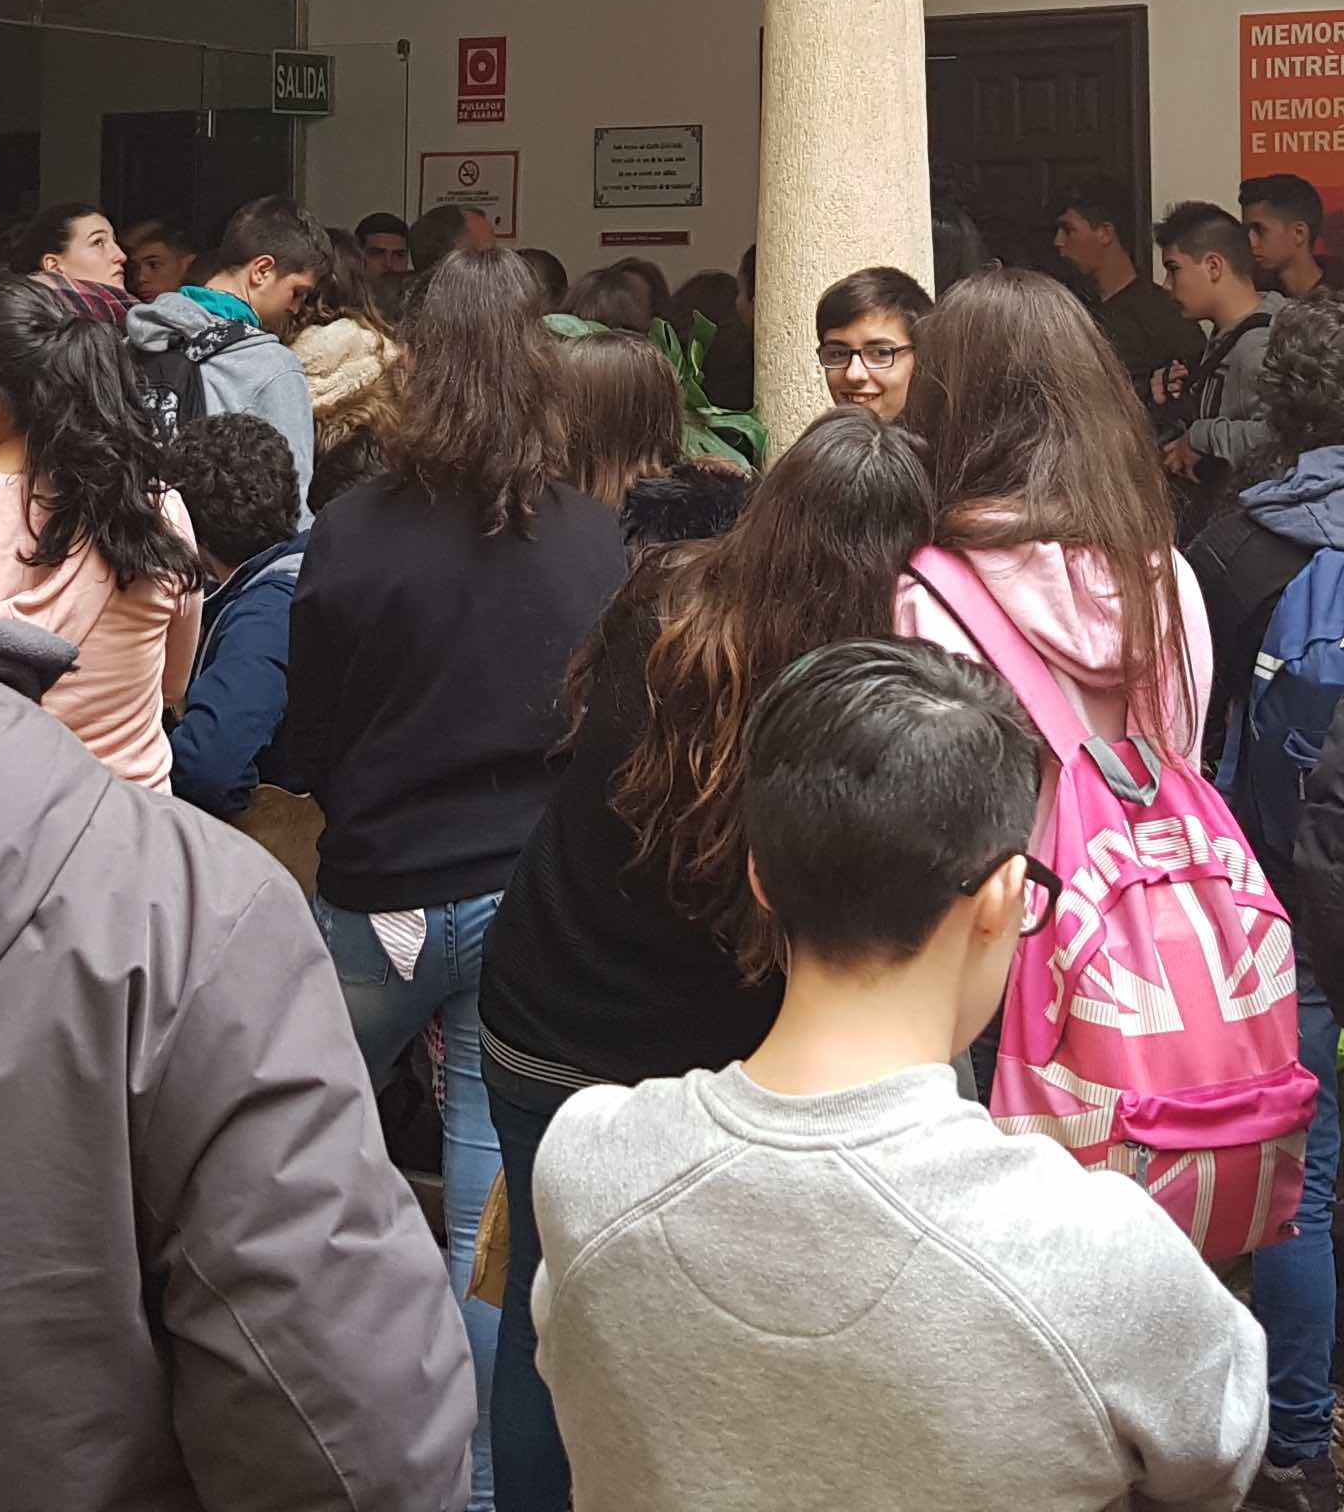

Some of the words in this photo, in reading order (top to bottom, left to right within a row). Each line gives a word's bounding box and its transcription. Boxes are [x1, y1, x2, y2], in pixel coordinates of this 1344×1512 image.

[1251, 58, 1257, 79] I
[275, 64, 328, 100] SALIDA
[1251, 131, 1266, 154] E
